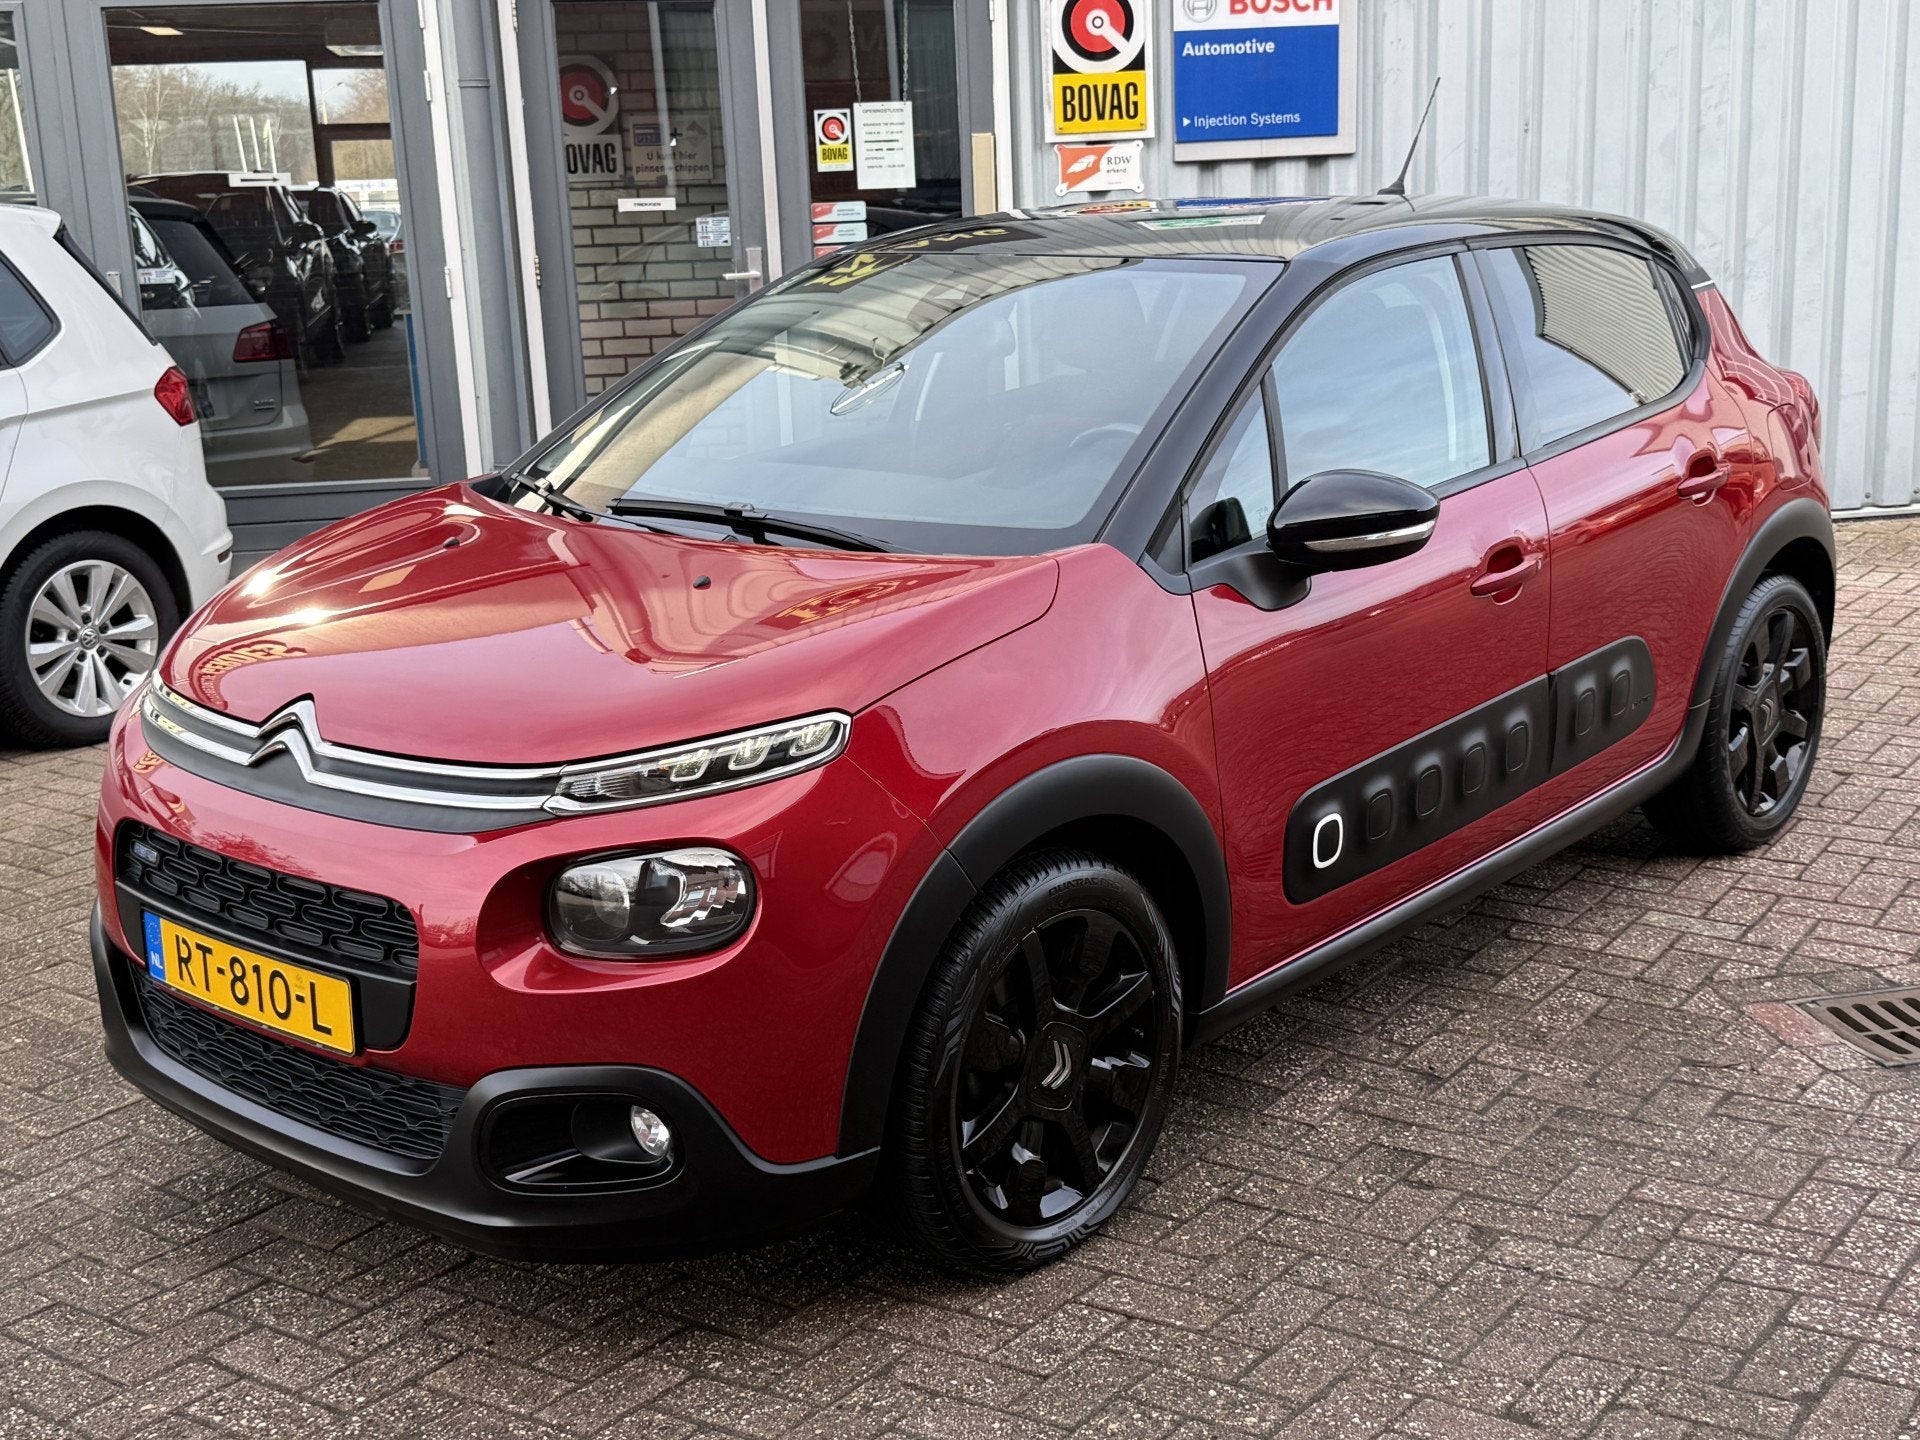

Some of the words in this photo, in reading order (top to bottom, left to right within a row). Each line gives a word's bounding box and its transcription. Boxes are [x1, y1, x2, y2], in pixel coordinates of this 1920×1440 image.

[1182, 38, 1276, 57] Automotive
[1062, 82, 1139, 123] BOVAG
[1193, 115, 1247, 128] Injection
[1250, 112, 1301, 126] Systems
[565, 143, 617, 174] OVAG
[822, 147, 848, 161] BOVAG
[1106, 155, 1132, 165] RDW
[675, 162, 710, 174] chippen
[151, 950, 163, 970] NL
[174, 933, 333, 1036] RT-810-L
